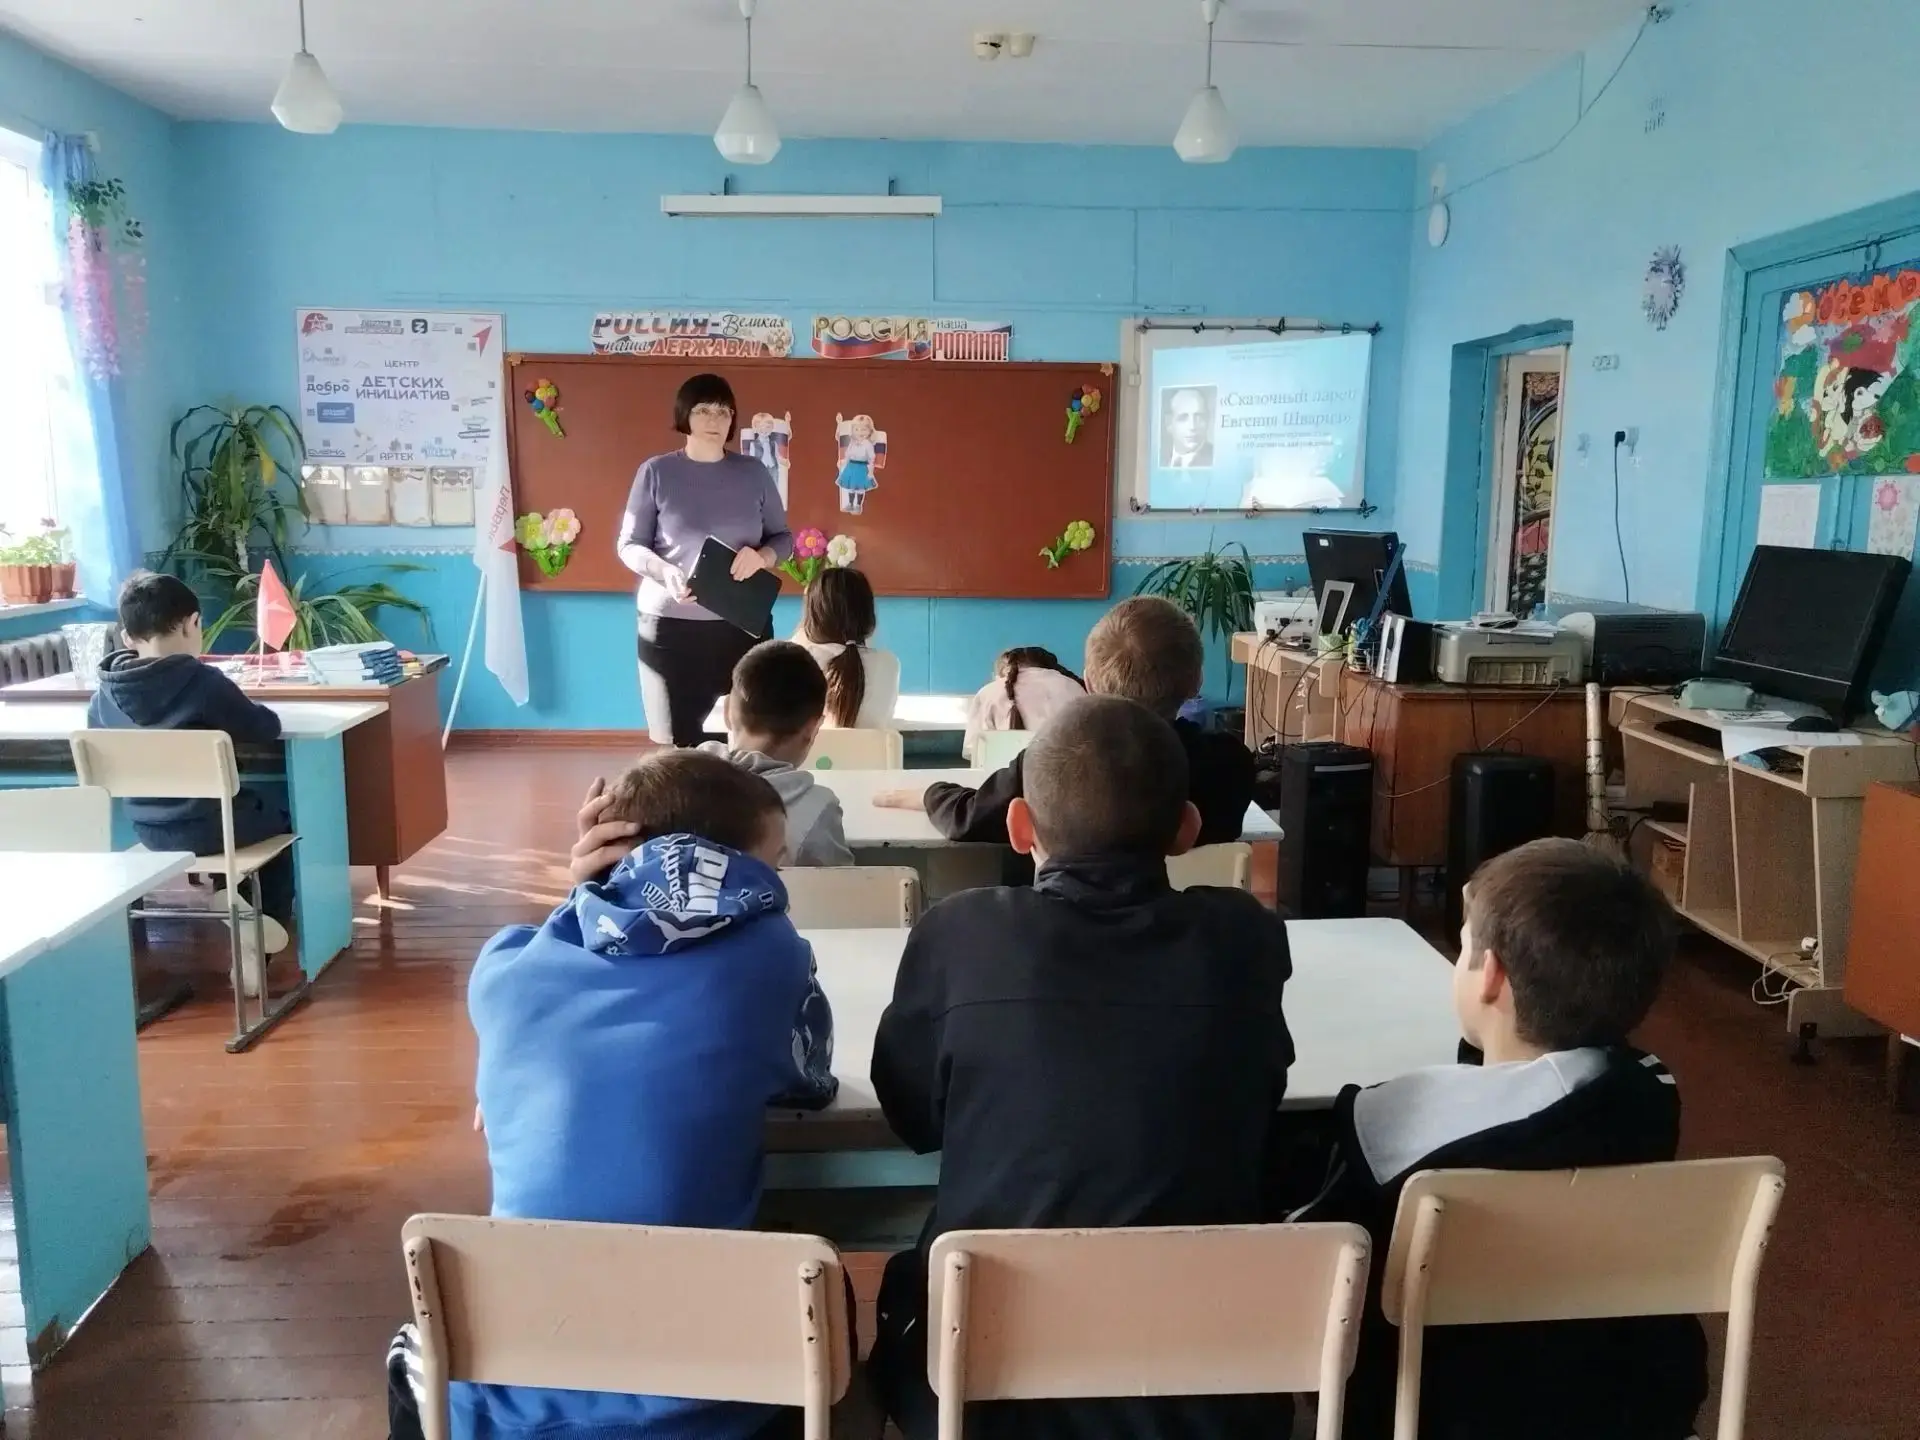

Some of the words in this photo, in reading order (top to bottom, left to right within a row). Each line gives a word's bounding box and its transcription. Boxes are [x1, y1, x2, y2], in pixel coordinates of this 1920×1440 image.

[814, 317, 929, 341] РОССИЯ
[651, 338, 761, 356] ДЕРЖАВА!
[932, 332, 1009, 361] РОДИНА!
[384, 359, 420, 369] ЦЕНТР
[362, 375, 444, 389] ДЕТСКИХ
[356, 388, 450, 401] ИНИЦИАТИВ
[379, 452, 415, 462] АРТЕК
